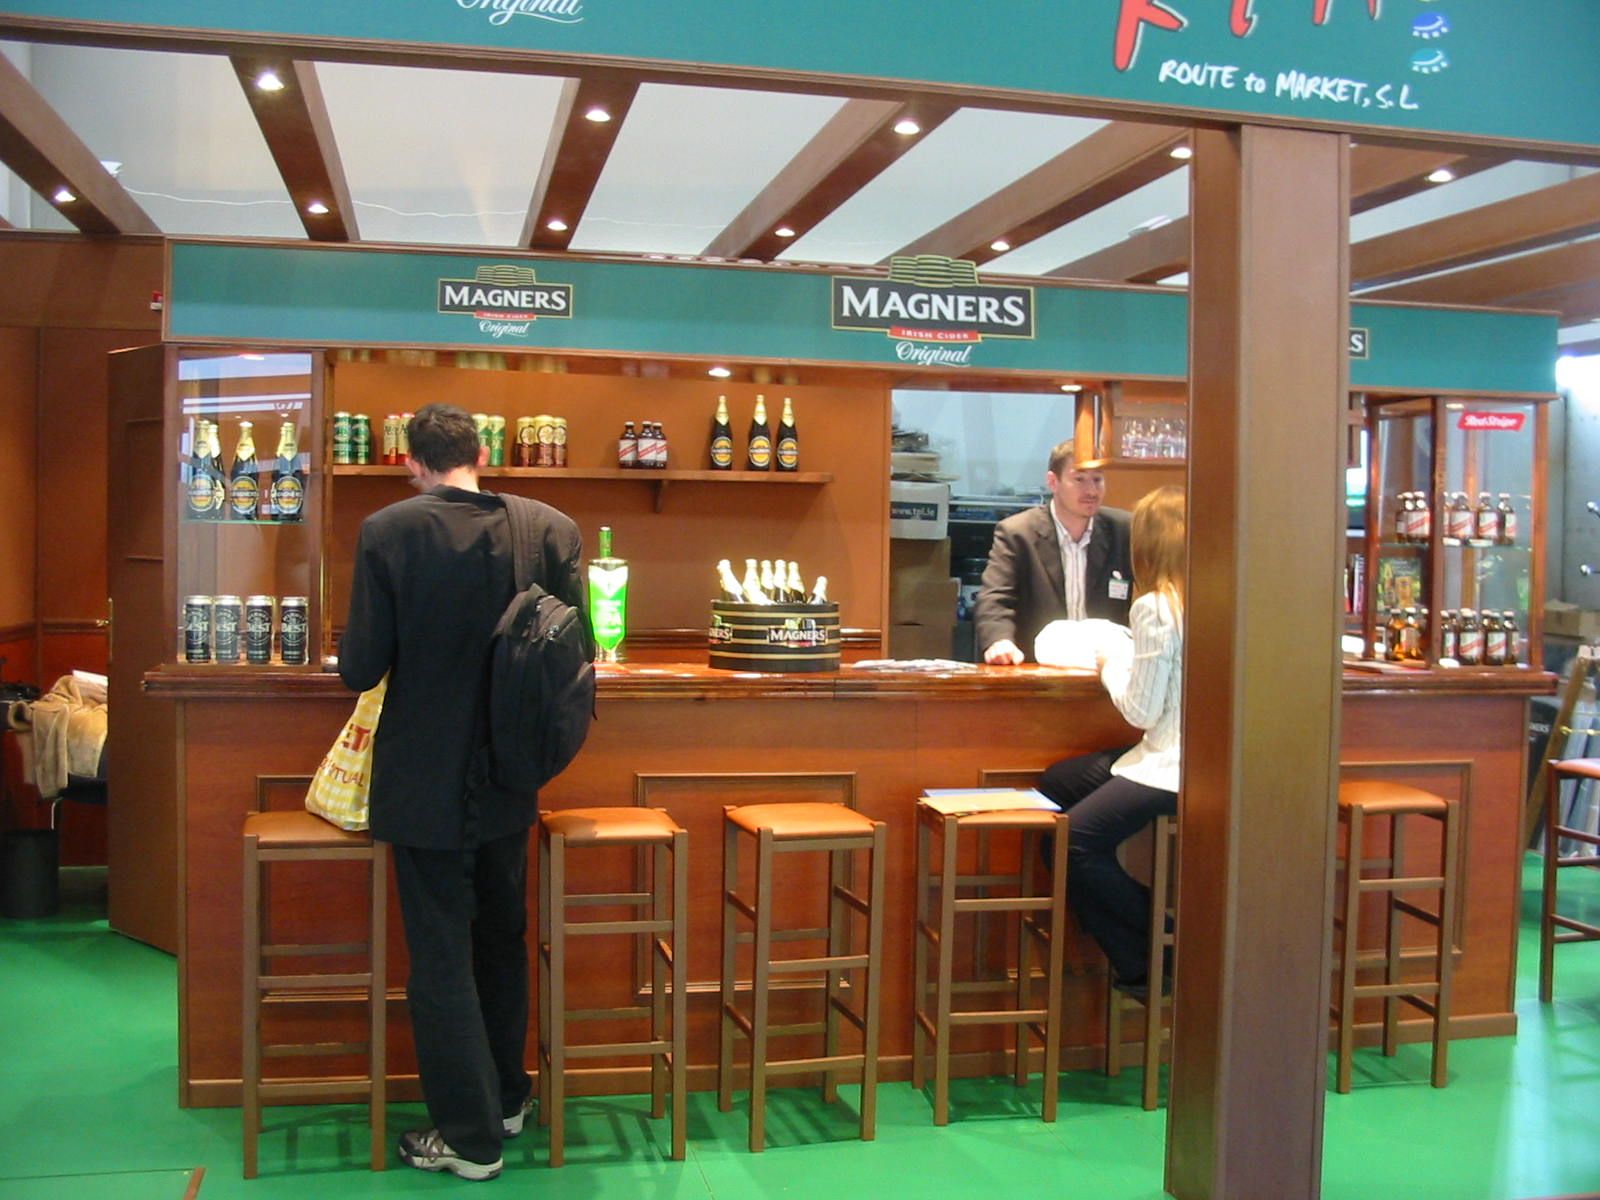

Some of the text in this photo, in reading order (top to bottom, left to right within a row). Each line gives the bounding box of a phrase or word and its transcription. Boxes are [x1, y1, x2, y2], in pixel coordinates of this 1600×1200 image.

[1158, 60, 1239, 88] ROUTE
[1244, 72, 1266, 93] to
[1275, 70, 1371, 108] MARKET,
[444, 285, 567, 310] MAGNERS
[841, 285, 1026, 327] MAGNERS
[479, 320, 530, 338] Original
[901, 329, 969, 340] IRISH CIDER
[895, 341, 973, 368] Original
[770, 629, 825, 641] MAGNERS
